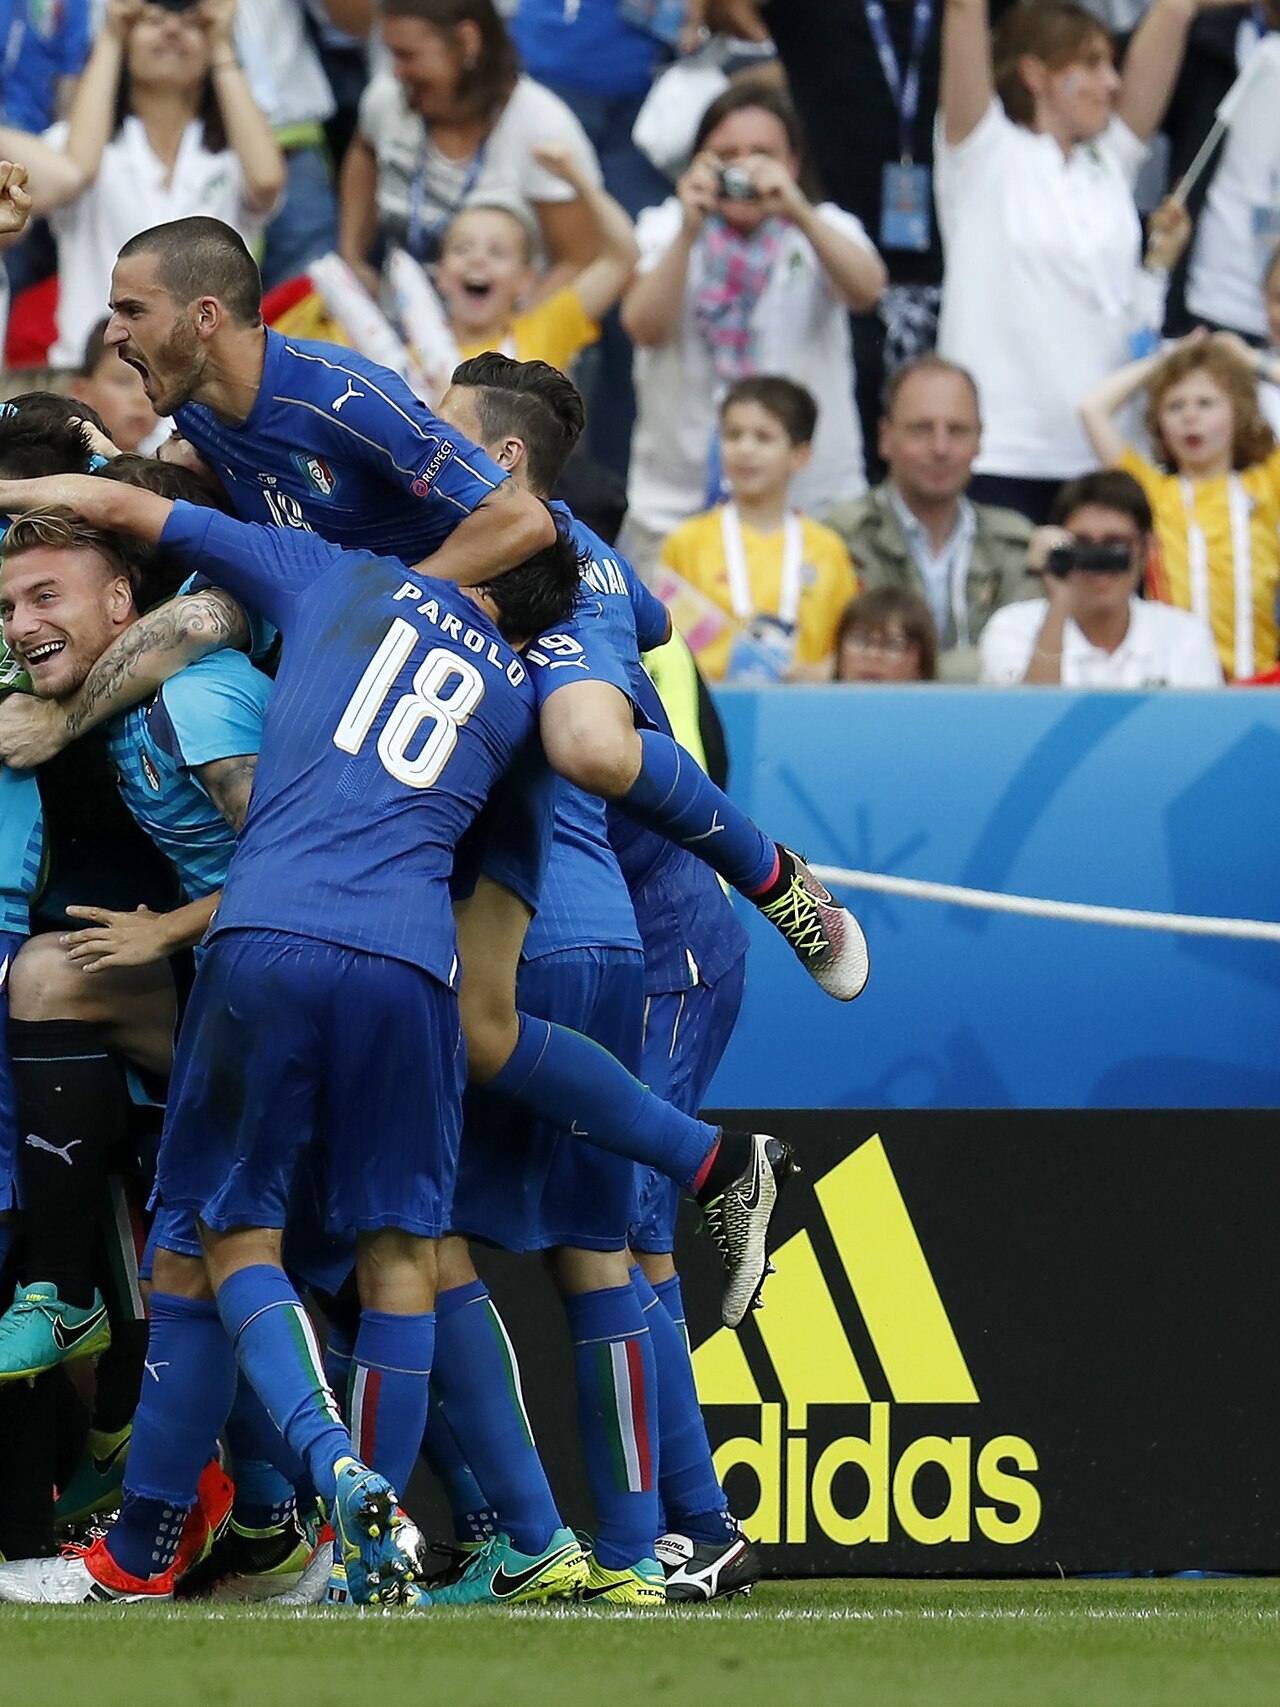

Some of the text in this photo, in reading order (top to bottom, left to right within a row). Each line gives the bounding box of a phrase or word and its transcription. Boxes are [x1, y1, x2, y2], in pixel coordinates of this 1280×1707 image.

[422, 439, 453, 483] RESPECT
[392, 581, 526, 687] PAROLO
[333, 616, 486, 788] 18
[711, 1400, 1042, 1545] didas
